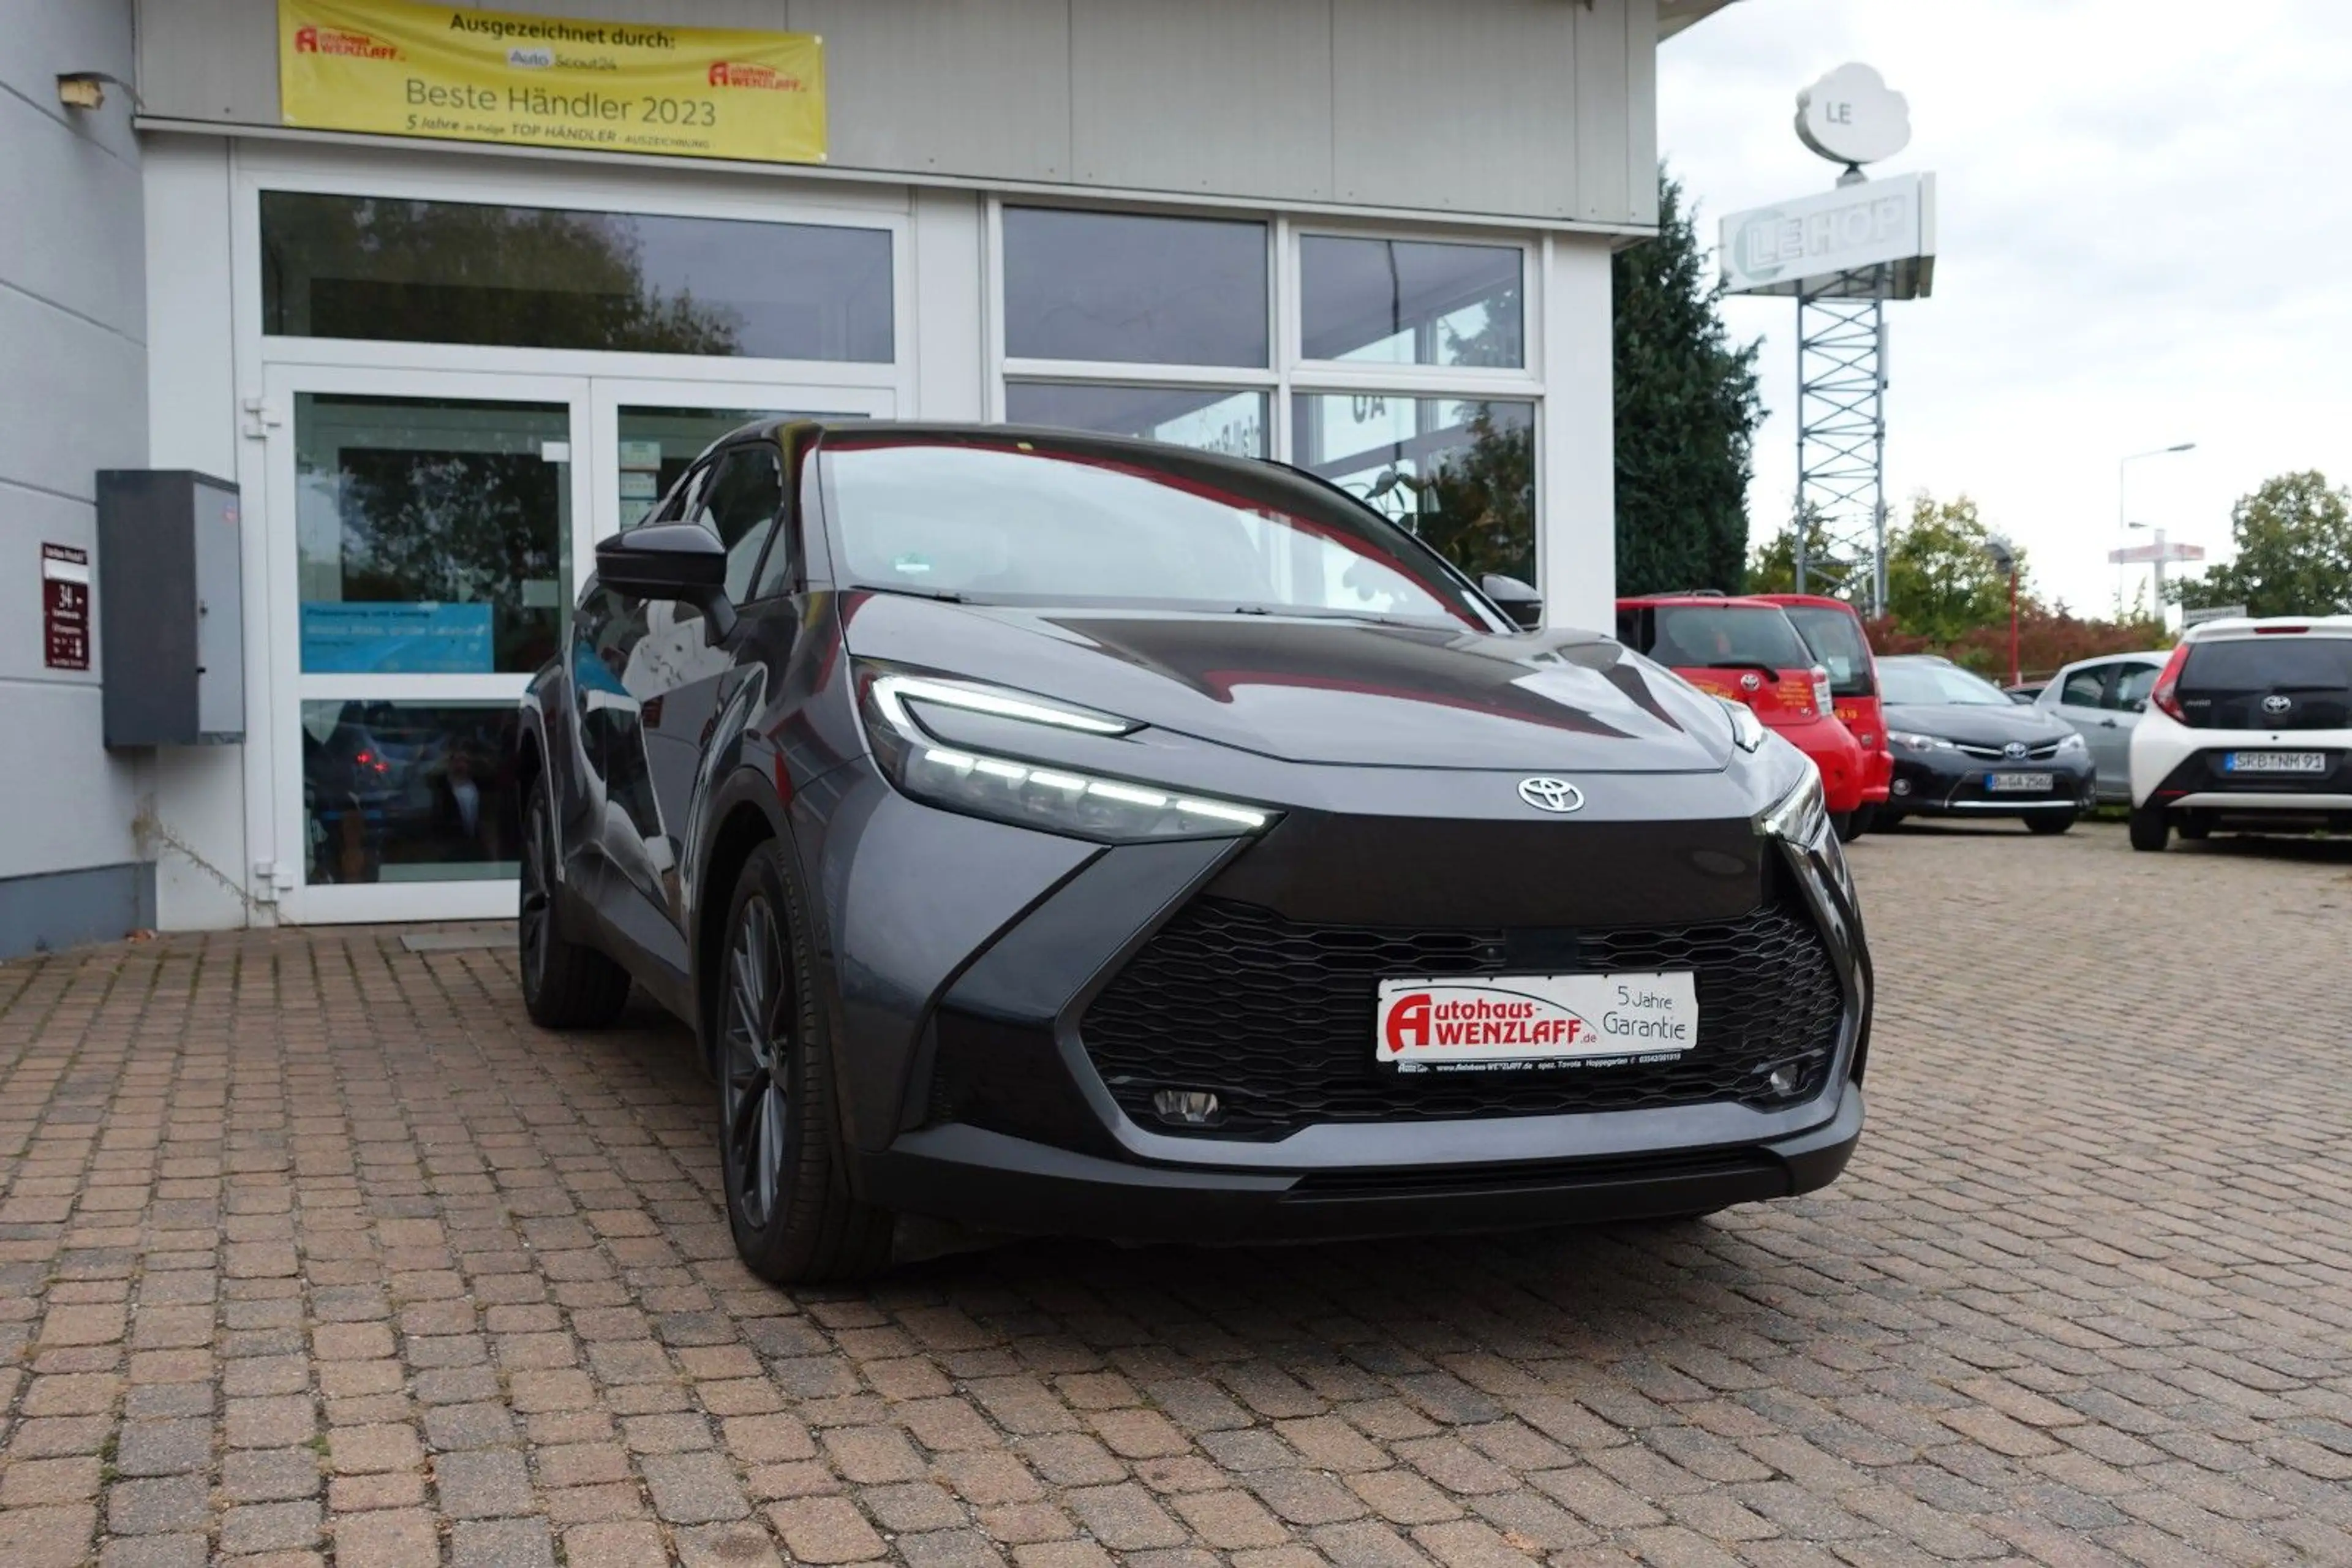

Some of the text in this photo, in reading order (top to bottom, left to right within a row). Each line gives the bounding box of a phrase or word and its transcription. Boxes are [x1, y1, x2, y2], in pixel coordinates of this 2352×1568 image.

[450, 13, 676, 48] Ausgezeichnet durch:
[406, 78, 717, 127] Beste Händler 2023
[1826, 101, 1852, 125] LE
[407, 114, 417, 130] 5
[512, 123, 541, 136] TOP
[544, 124, 617, 143] HÄNDLER
[1618, 986, 1673, 1009] 5 Jahre
[1603, 1011, 1686, 1039] Garantie
